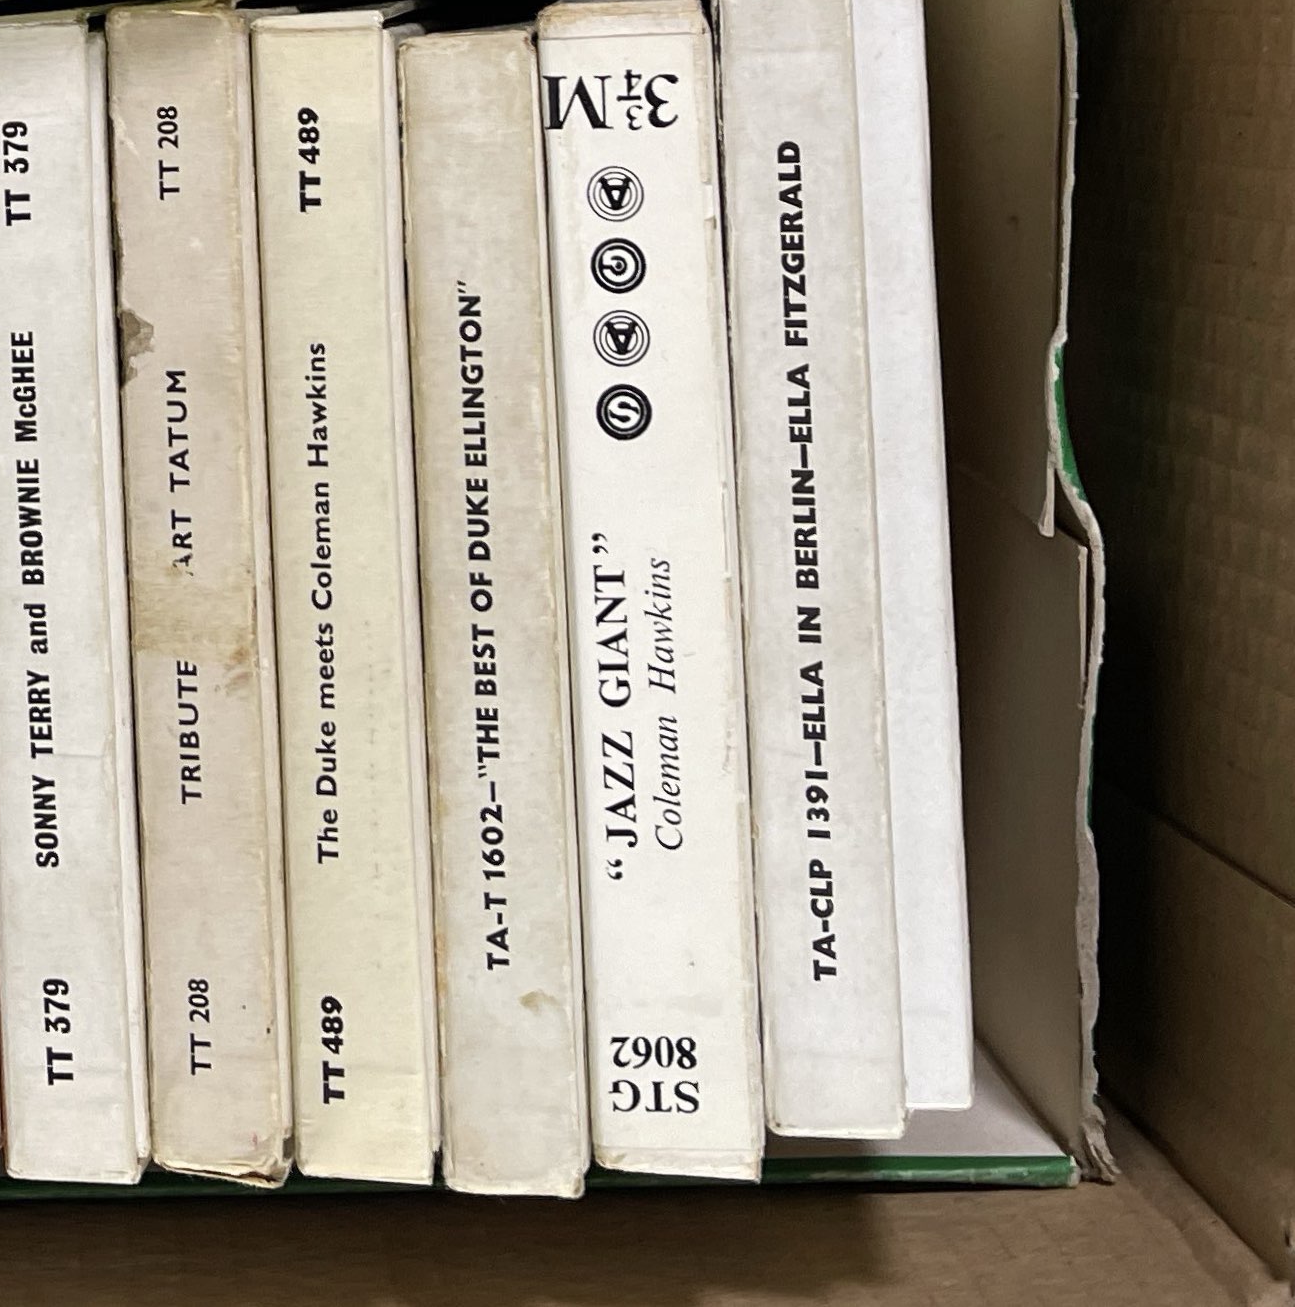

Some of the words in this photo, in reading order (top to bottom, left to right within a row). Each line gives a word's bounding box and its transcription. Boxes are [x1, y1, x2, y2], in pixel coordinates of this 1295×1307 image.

[2, 122, 28, 173] 379
[157, 106, 178, 148] 208
[298, 108, 320, 164] 489
[5, 189, 31, 226] TT
[159, 160, 179, 200] TT
[299, 171, 321, 212] TT
[778, 142, 808, 346] FITZGERALD
[11, 332, 37, 441] McGHEE
[305, 344, 328, 466] Hawkins
[166, 371, 190, 492] TATUM
[17, 459, 44, 584] BROWNIE
[311, 483, 332, 610] Coleman
[466, 479, 490, 560] DUKE
[470, 573, 492, 612] OF
[24, 604, 48, 654] and
[644, 558, 675, 693] Hawkins
[798, 606, 821, 643] IN
[316, 623, 335, 709] meets
[472, 624, 496, 695] BEST
[27, 670, 53, 759] TERRY
[177, 661, 201, 804] TRIBUTE
[315, 722, 336, 796] Duke
[653, 717, 682, 850] Coleman
[32, 775, 59, 867] SONNY
[317, 810, 338, 864] The
[484, 892, 509, 970] TA-T
[809, 859, 836, 981] TA-CLP
[43, 979, 70, 1033] 379
[188, 979, 209, 1022] 208
[321, 996, 343, 1054] 489
[47, 1047, 73, 1085] TT
[190, 1033, 211, 1075] TT
[611, 1037, 696, 1069] 8062
[323, 1061, 344, 1104] TT
[609, 1080, 699, 1113] STG
